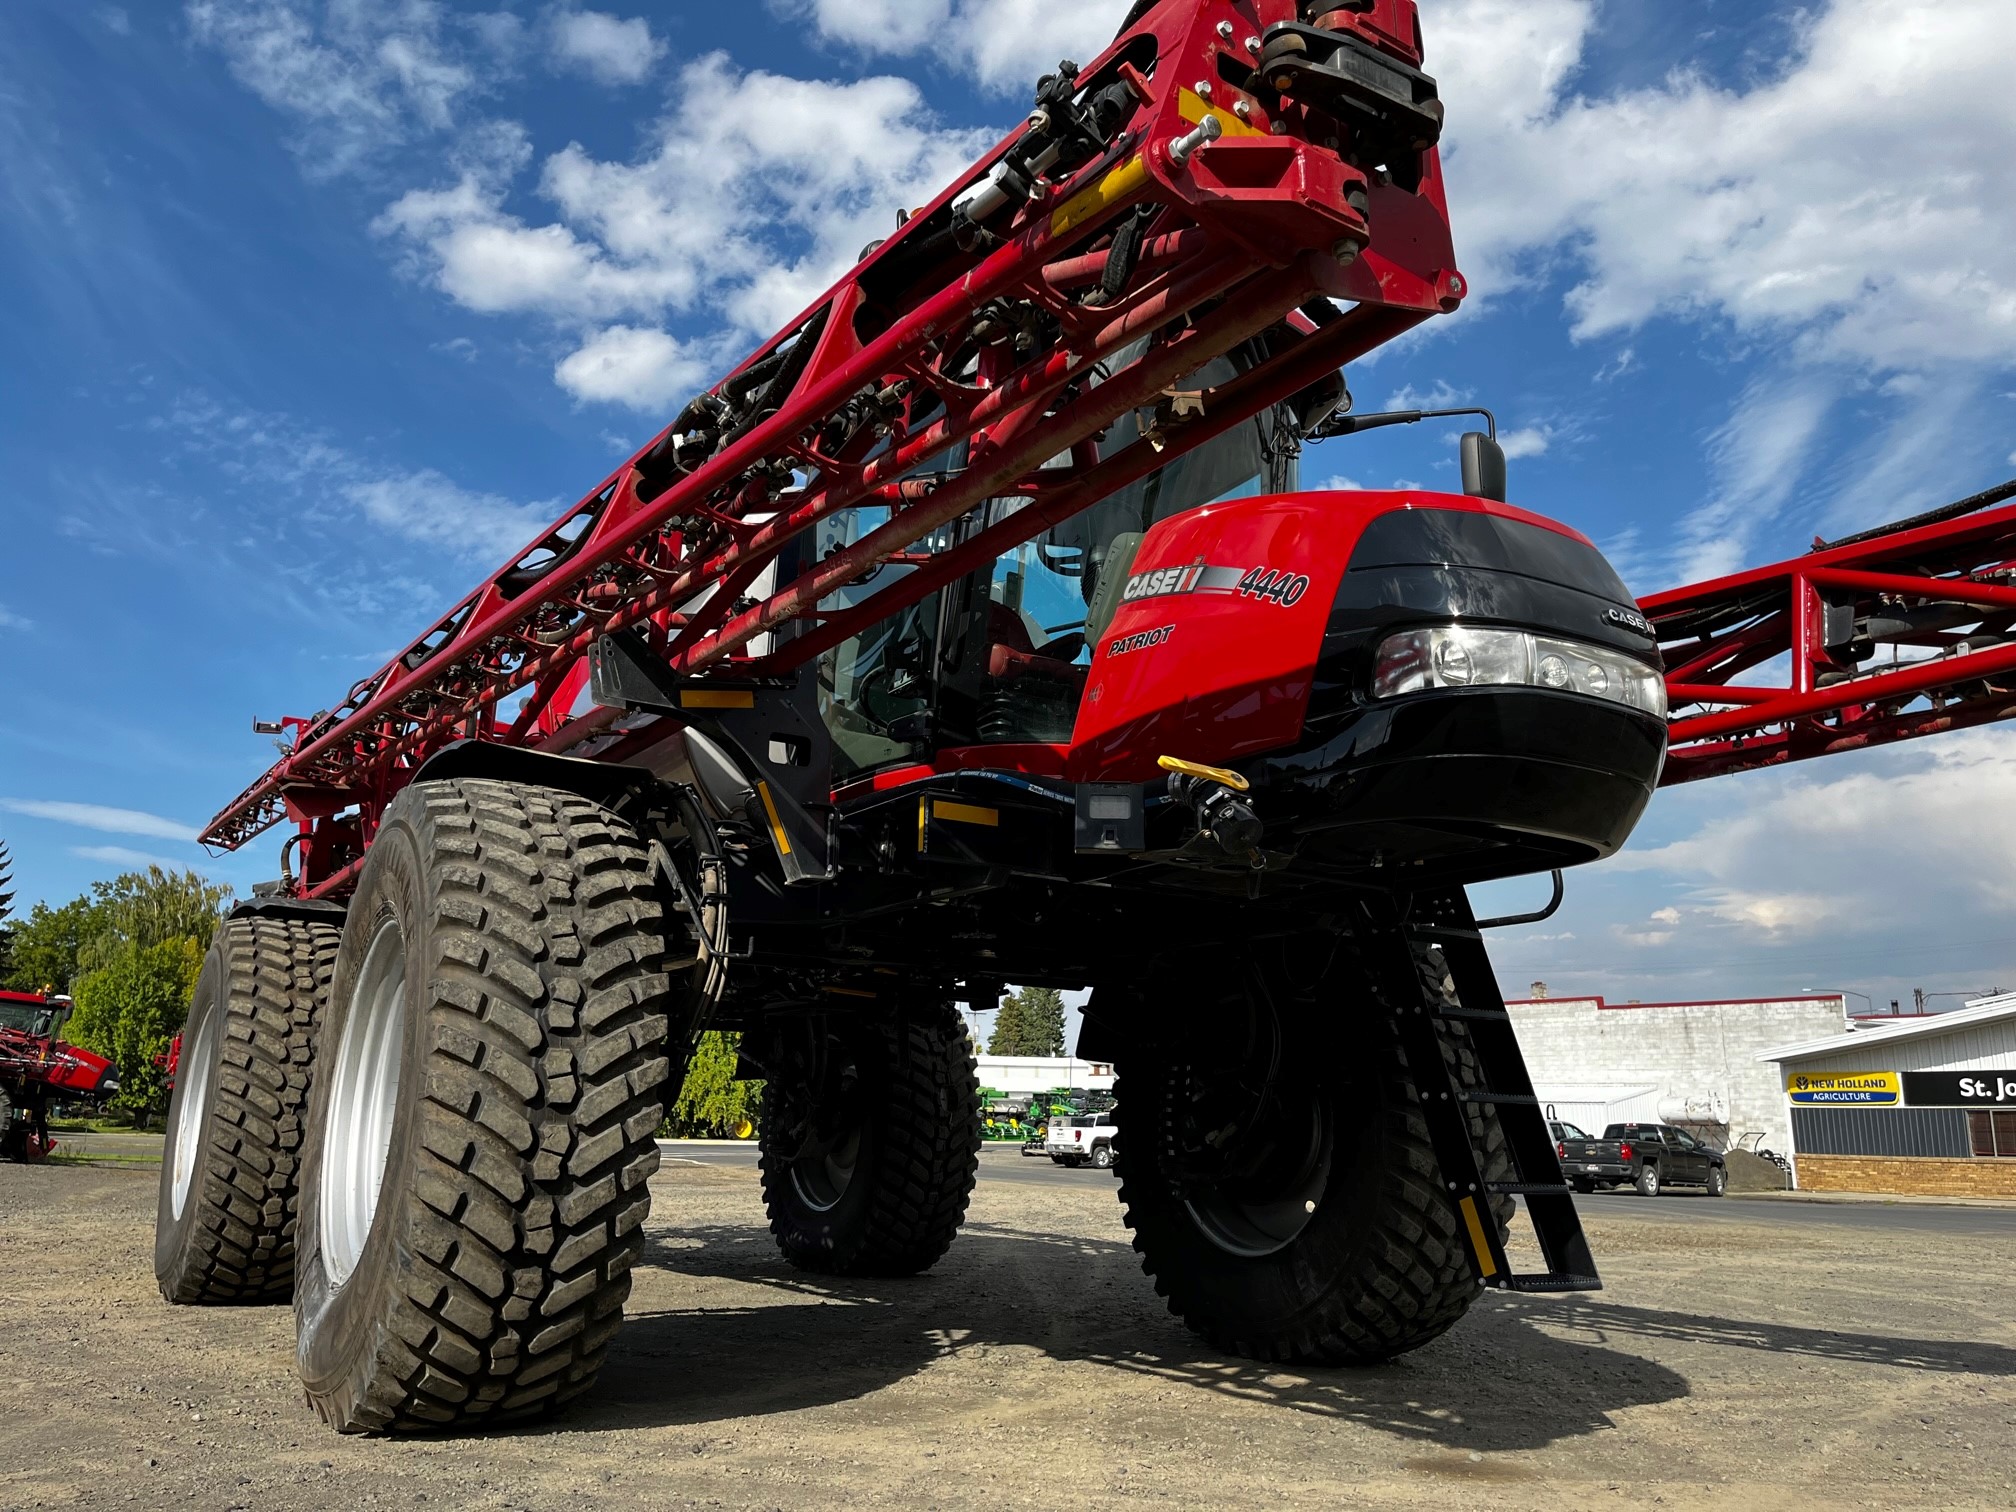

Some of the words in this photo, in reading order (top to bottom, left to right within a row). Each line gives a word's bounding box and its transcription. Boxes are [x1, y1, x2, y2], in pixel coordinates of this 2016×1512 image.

[1236, 565, 1310, 608] 4440
[1608, 608, 1645, 630] CASE
[1106, 623, 1177, 659] PATRIOT
[1811, 1079, 1835, 1088] NEW
[1838, 1079, 1887, 1088] HOLLAND
[1959, 1077, 1992, 1097] St.
[1995, 1077, 2016, 1102] Jo
[1812, 1092, 1872, 1101] AGRICULTURE
